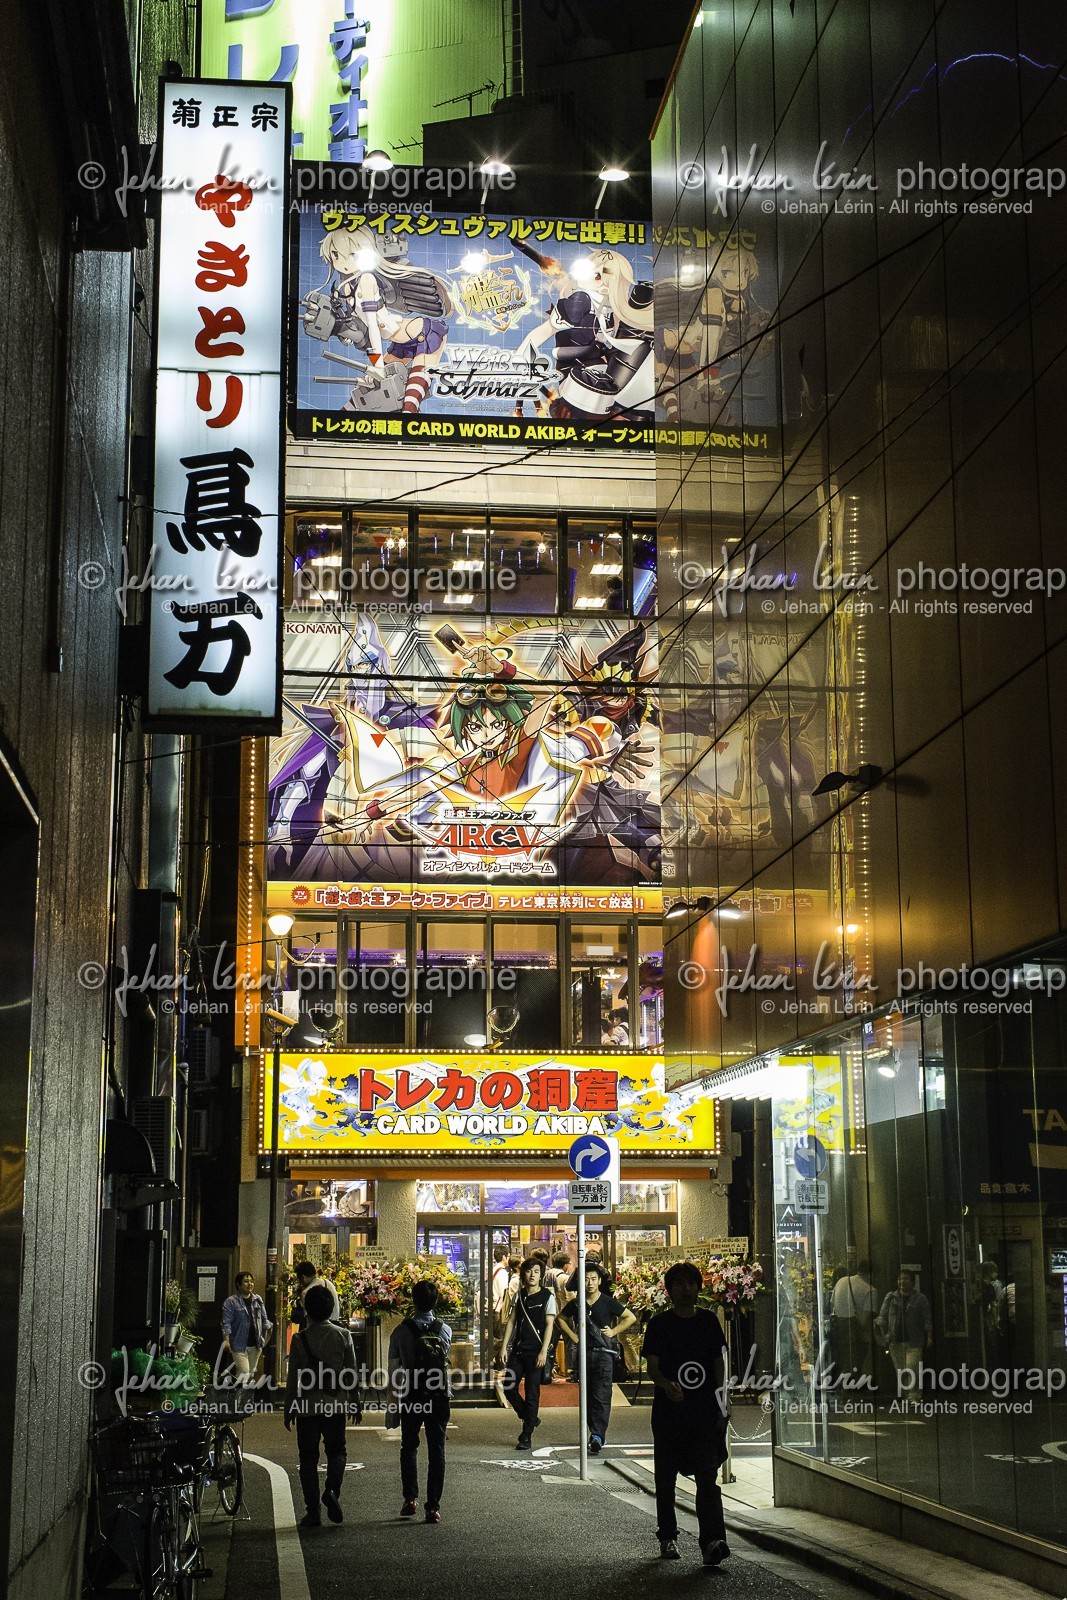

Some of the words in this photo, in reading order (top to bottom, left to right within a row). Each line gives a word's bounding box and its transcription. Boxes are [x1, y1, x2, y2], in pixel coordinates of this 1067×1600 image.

[172, 98, 279, 132] 菊正宗
[321, 210, 646, 245] ヴァイスシュヴァルツに出撃!!
[436, 369, 540, 400] Schwarz
[311, 416, 403, 436] トレカの洞窟
[407, 420, 455, 437] CARD
[459, 423, 521, 439] WORLD
[524, 427, 576, 442] AKIBA
[582, 429, 655, 445] オープン!!
[286, 623, 342, 635] KONAMI
[424, 861, 555, 874] オフィシャルカードゲーム
[357, 1067, 619, 1112] トレカの洞窟
[377, 1114, 441, 1135] CARD
[447, 1115, 527, 1135] WORLD
[534, 1115, 605, 1136] AKIBA
[571, 1184, 608, 1194] 自転車を除く
[571, 1194, 608, 1203] 一方通行
